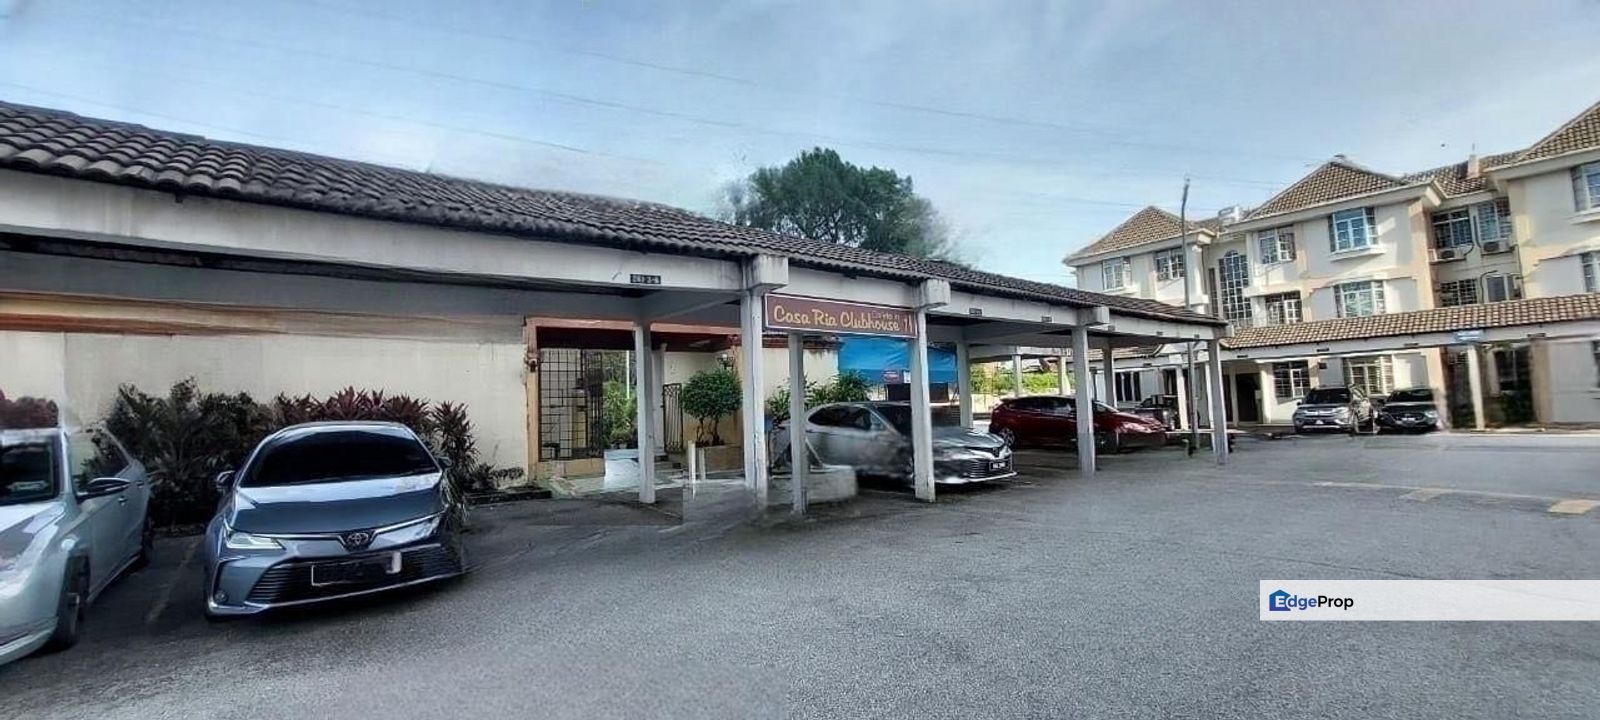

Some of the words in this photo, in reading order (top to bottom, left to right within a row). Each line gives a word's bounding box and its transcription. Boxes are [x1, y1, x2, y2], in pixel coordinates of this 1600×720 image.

[774, 305, 811, 325] Casa
[812, 308, 838, 327] Ria
[840, 311, 901, 332] Clubhouse
